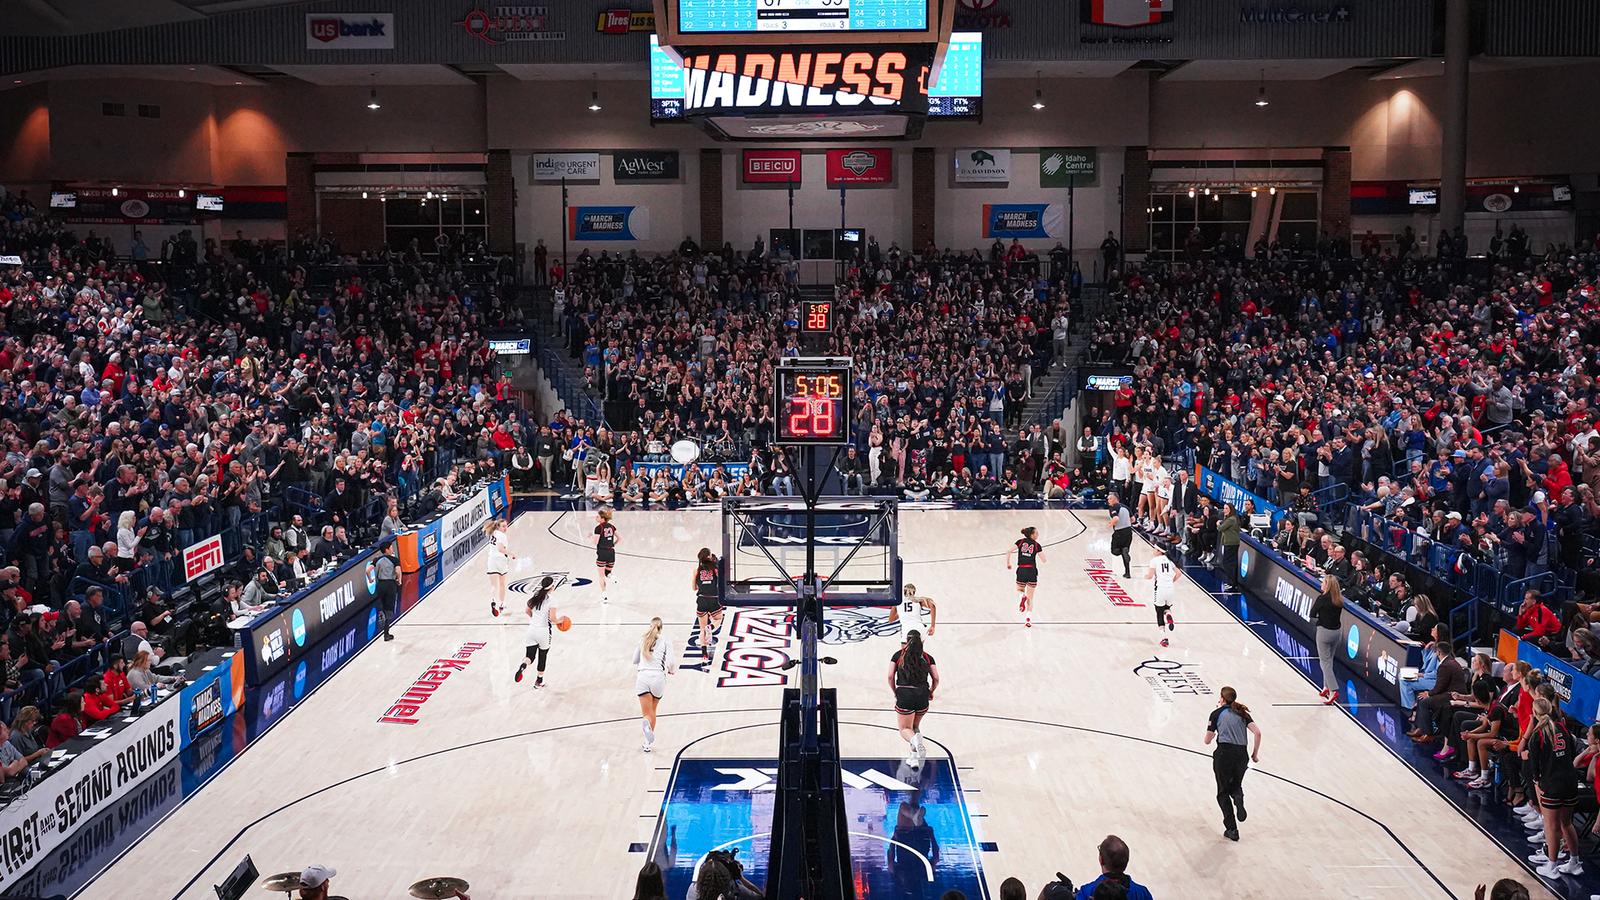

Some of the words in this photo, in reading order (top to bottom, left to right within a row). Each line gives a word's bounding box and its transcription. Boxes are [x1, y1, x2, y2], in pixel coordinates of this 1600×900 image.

[313, 23, 337, 37] us
[340, 19, 386, 36] bank
[607, 13, 629, 28] Tires
[782, 20, 788, 30] 3
[840, 20, 846, 29] 3
[683, 52, 907, 110] MADNESS
[617, 158, 665, 175] AgWest
[752, 161, 792, 171] BECU
[1065, 161, 1095, 170] Central
[1066, 155, 1087, 163] Idaho
[973, 168, 1006, 176] DAVIDSON
[590, 214, 613, 222] MARCH
[1003, 212, 1027, 220] MARCH
[593, 222, 624, 230] MADNESS
[1006, 220, 1038, 228] MADNESS
[810, 304, 828, 313] 5:05
[808, 314, 826, 329] 28
[796, 375, 840, 396] 5:05
[791, 399, 832, 434] 28
[186, 540, 221, 579] ESPN
[1161, 563, 1169, 573] 14
[320, 591, 338, 623] FOUR
[336, 586, 344, 611] IT
[343, 580, 355, 606] ALL
[1275, 576, 1294, 608] FOUR
[1292, 588, 1302, 612] IT
[1299, 593, 1313, 622] ALL
[903, 601, 913, 613] 15
[1547, 667, 1566, 684] MARCH
[377, 659, 471, 725] Kennel
[198, 697, 223, 726] MADNESS
[40, 812, 56, 839] AND
[55, 761, 113, 834] SECOND
[116, 719, 175, 789] ROUNDS
